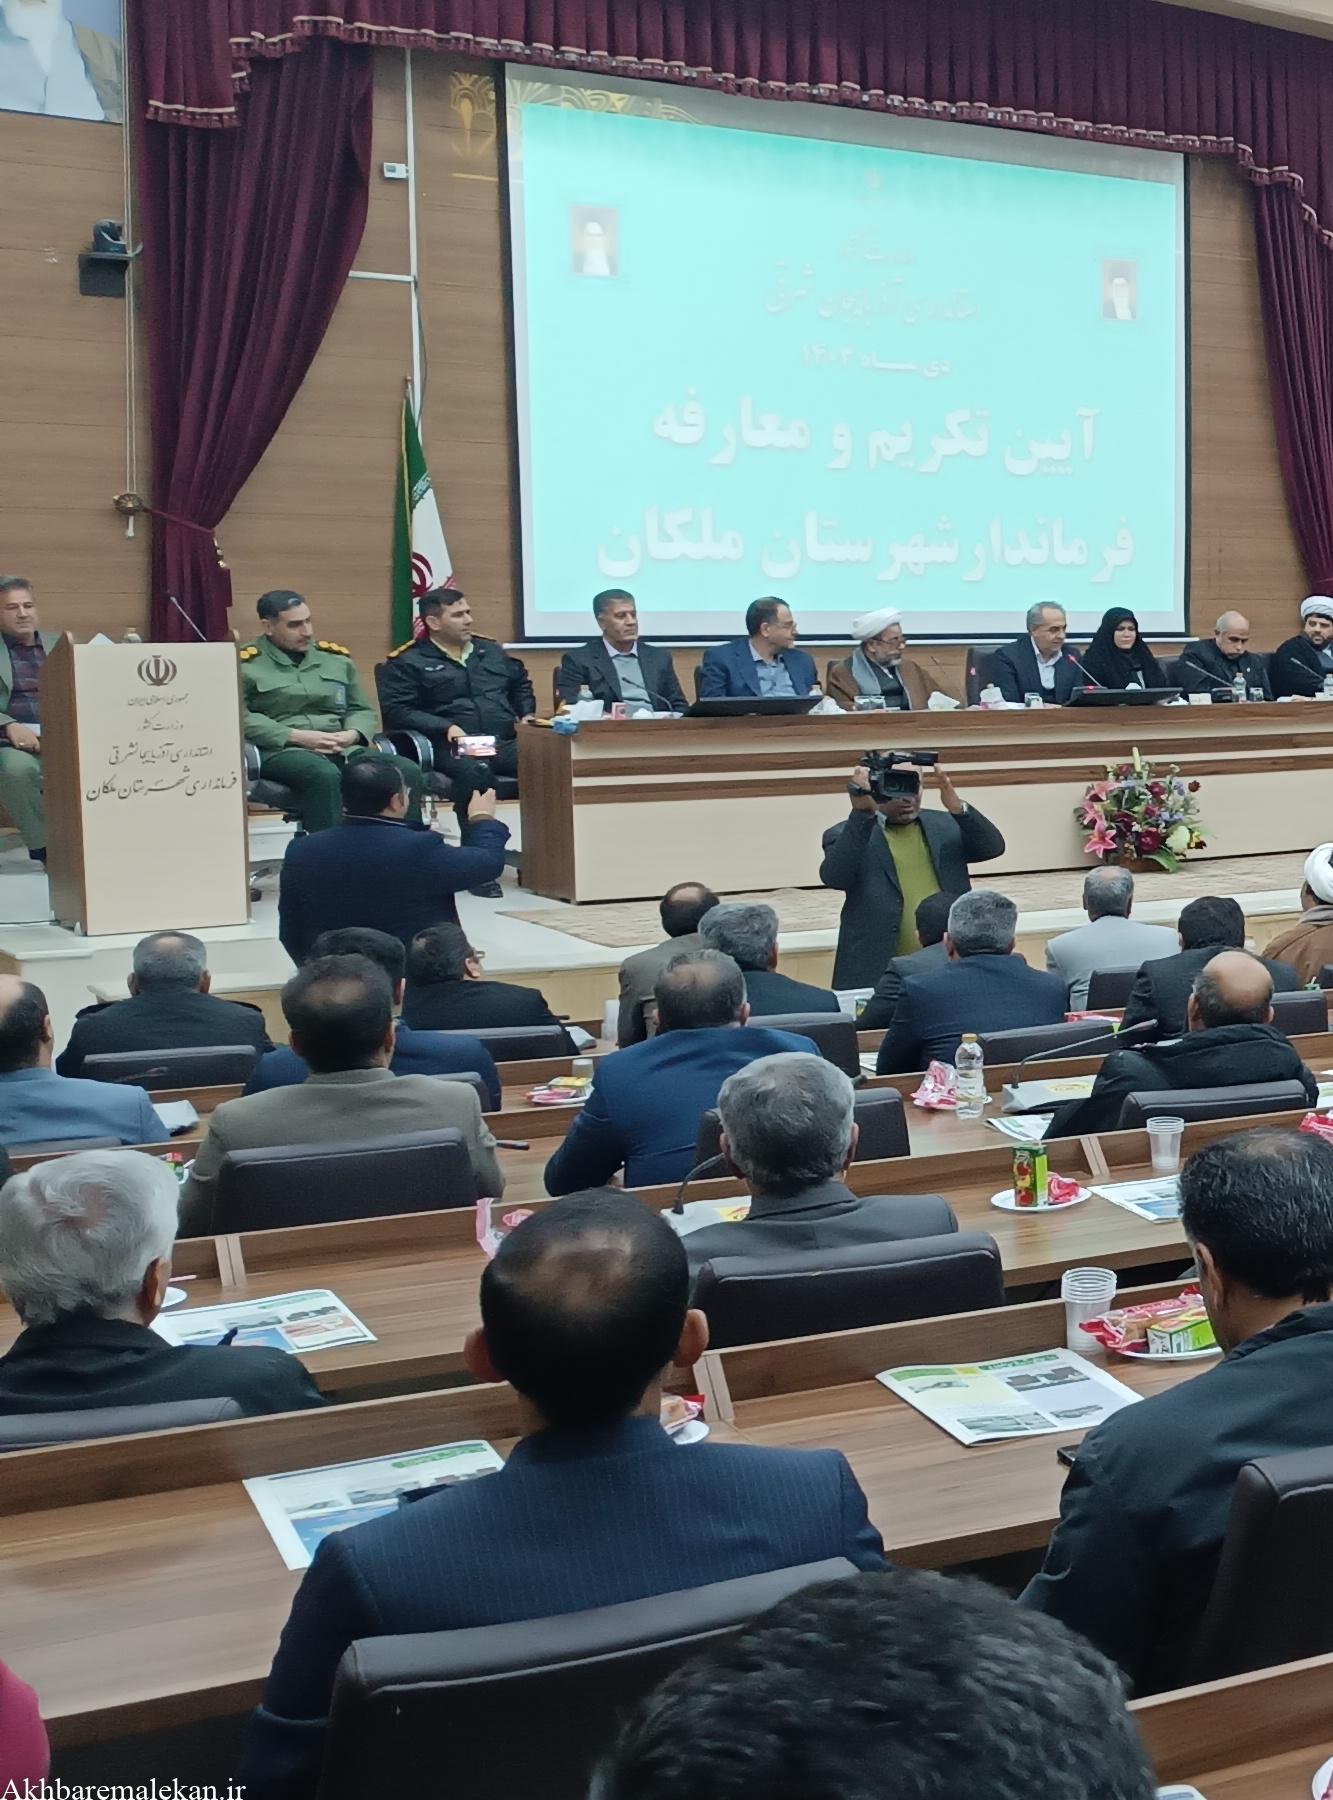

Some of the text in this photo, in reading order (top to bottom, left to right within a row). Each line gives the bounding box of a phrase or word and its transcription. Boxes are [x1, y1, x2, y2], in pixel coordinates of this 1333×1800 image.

[653, 389, 1101, 474] آیین تکریم و معارفه
[597, 504, 1134, 583] فرماندار شهرستان ملکان
[86, 774, 117, 801] ملکان
[185, 771, 238, 797] فرمانداری
